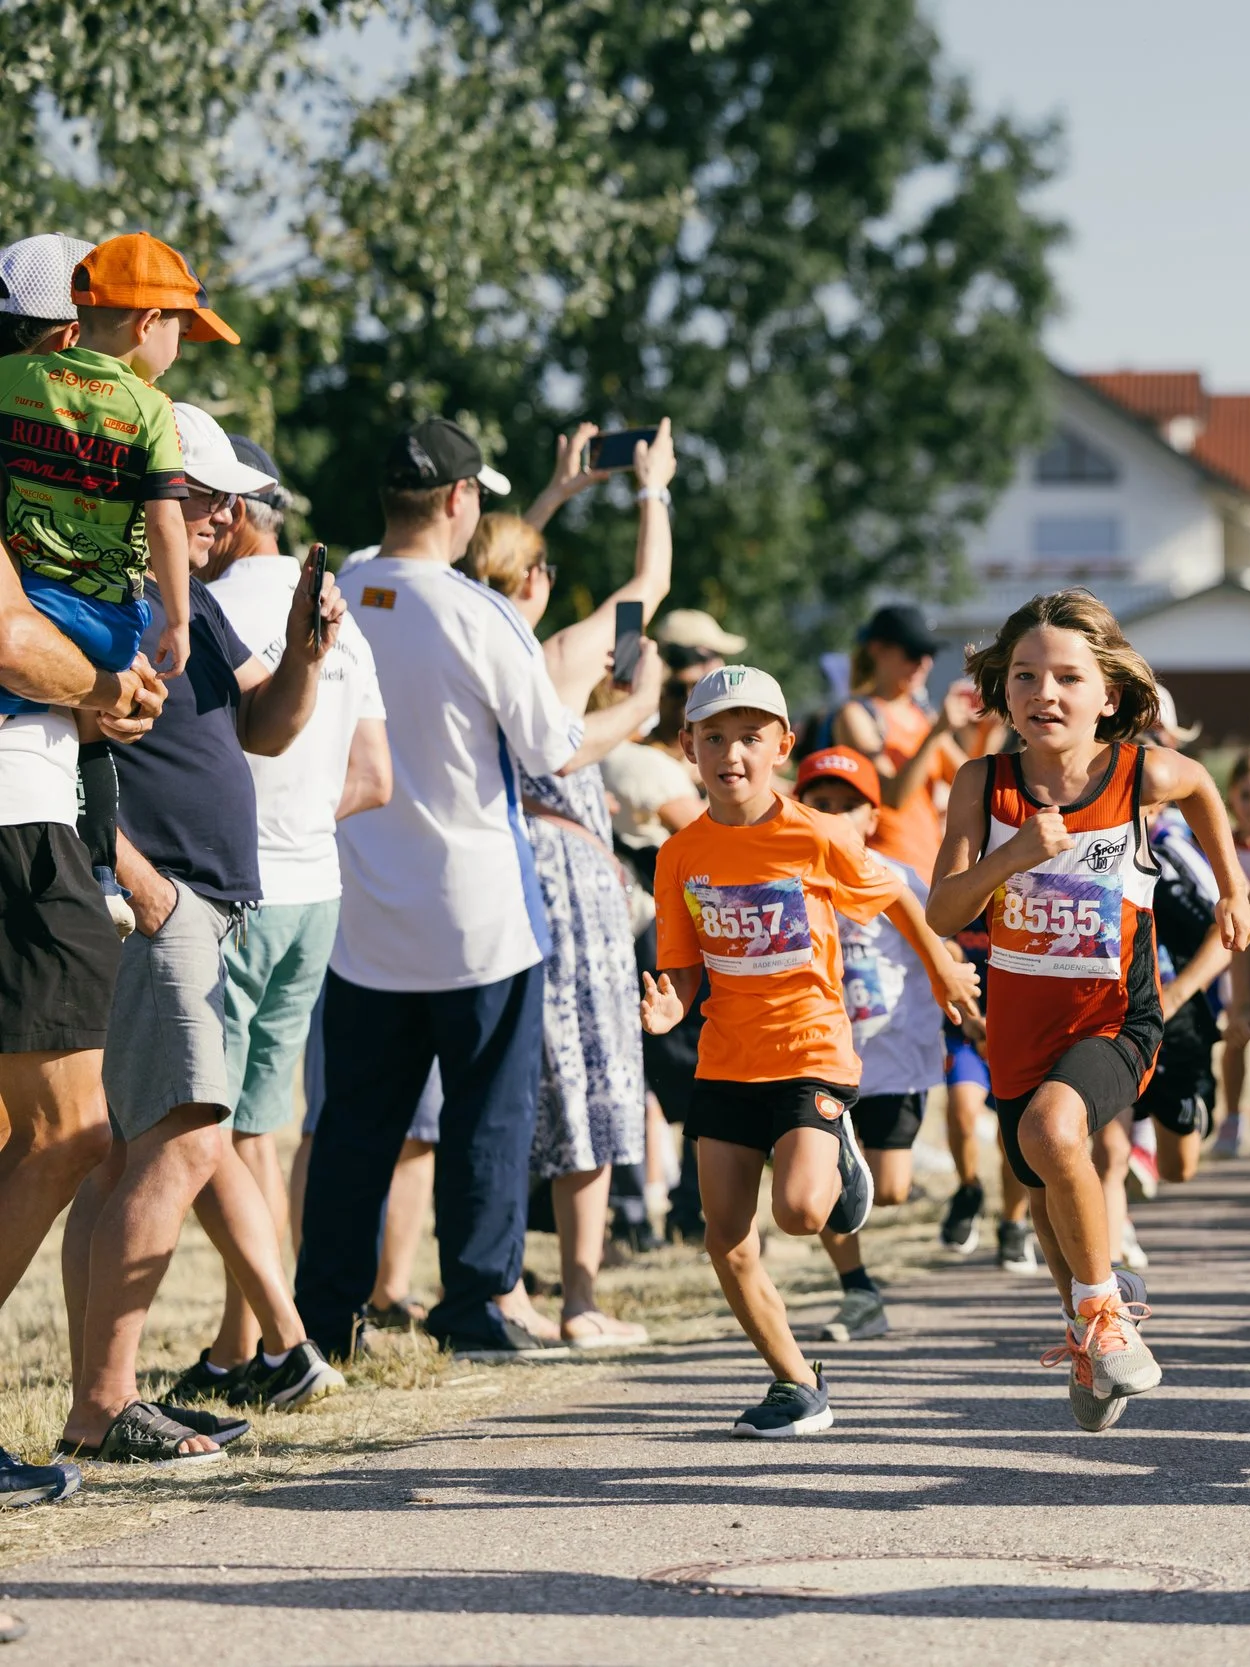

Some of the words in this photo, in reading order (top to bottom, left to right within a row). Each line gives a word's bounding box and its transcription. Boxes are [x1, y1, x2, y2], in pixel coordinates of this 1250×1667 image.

[49, 368, 114, 396] eleven
[702, 902, 784, 939] 8557
[1003, 893, 1101, 937] 8555
